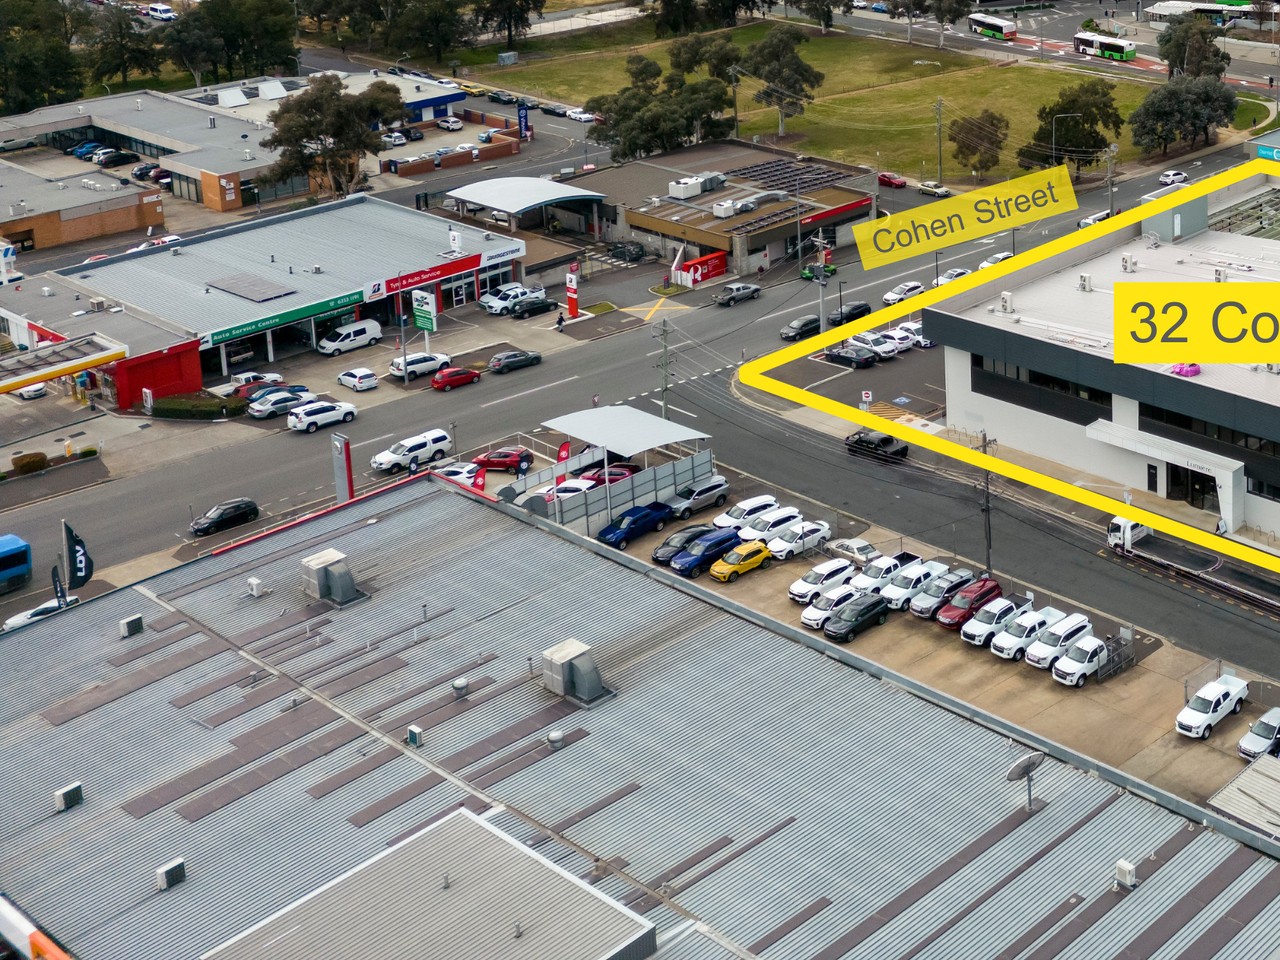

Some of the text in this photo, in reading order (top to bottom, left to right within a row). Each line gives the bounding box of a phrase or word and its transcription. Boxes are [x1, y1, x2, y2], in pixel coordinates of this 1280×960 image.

[407, 276, 420, 284] Auto
[420, 270, 441, 281] Service
[213, 318, 280, 341] Auto Service Centre
[75, 545, 86, 577] LDV
